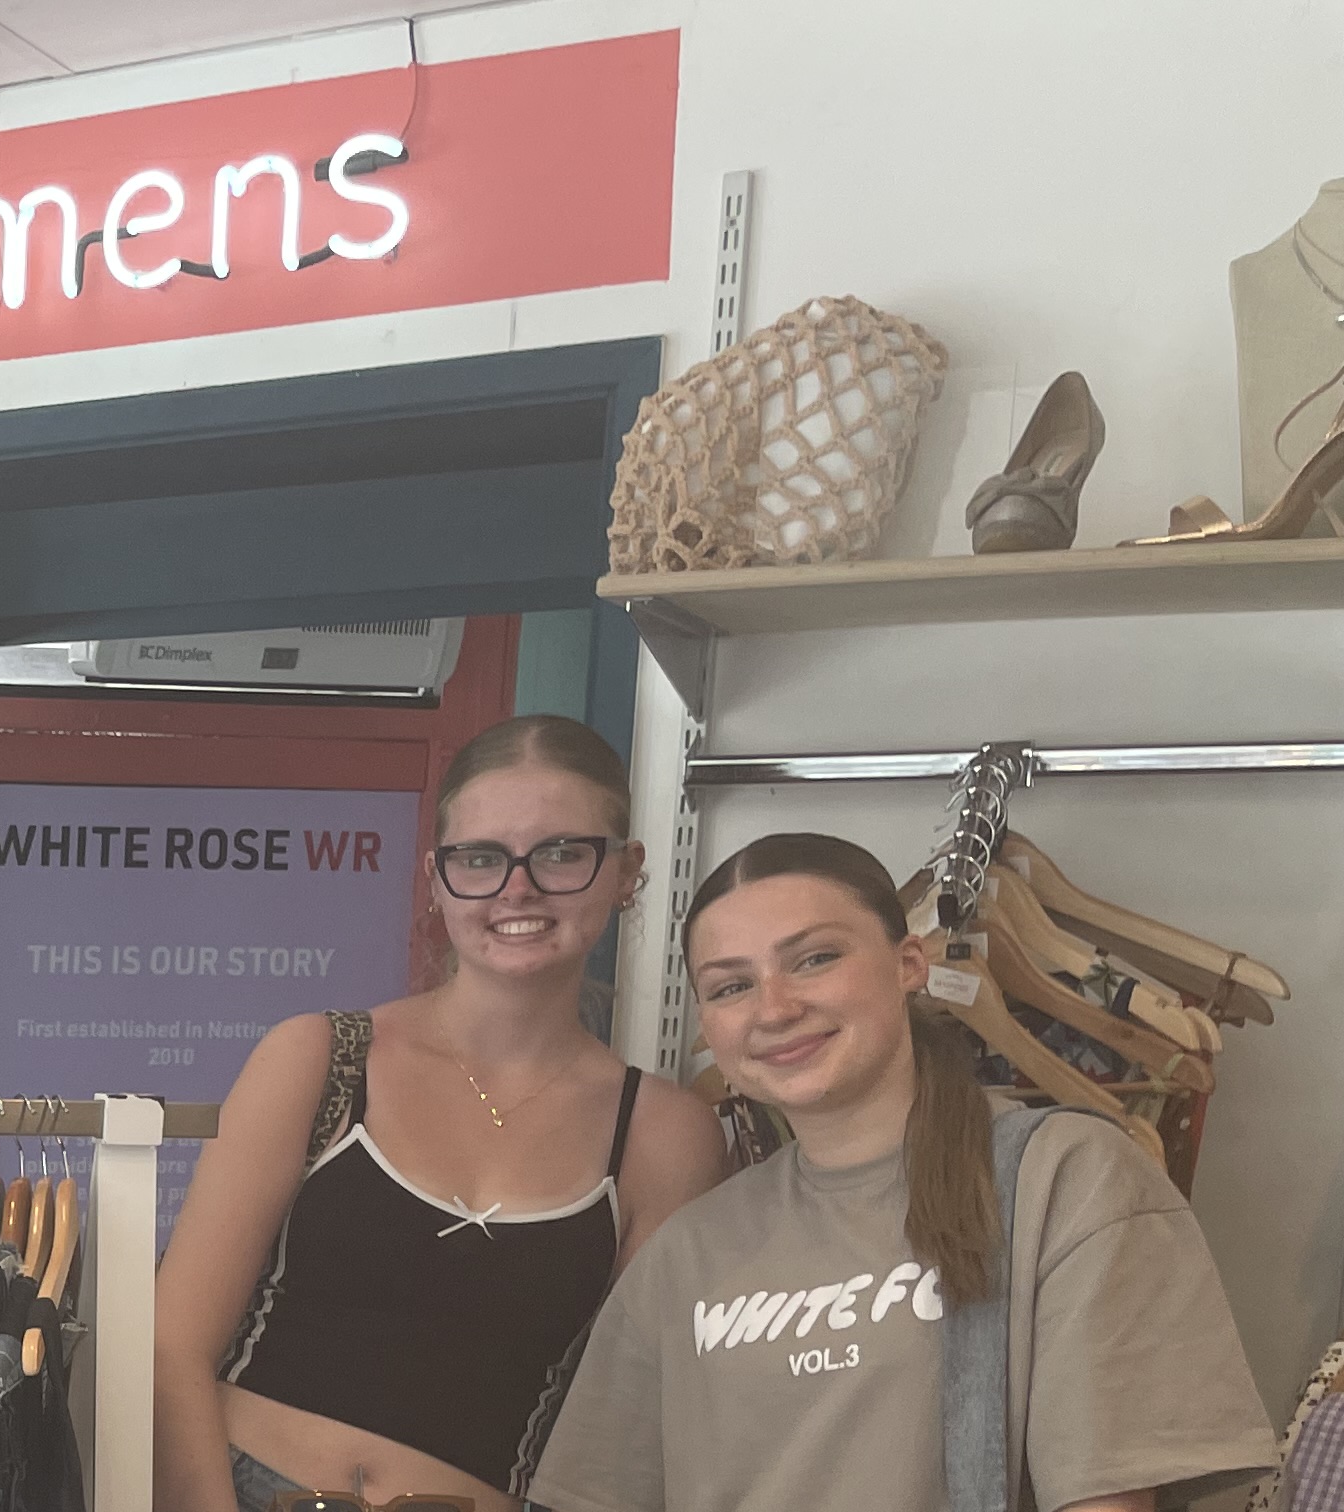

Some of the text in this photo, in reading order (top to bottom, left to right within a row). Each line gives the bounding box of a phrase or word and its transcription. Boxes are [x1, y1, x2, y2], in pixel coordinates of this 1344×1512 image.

[155, 645, 213, 662] Dimplex
[165, 827, 290, 871] ROSE
[304, 830, 382, 872] WR
[27, 945, 336, 977] THIS IS OUR STORY
[17, 1019, 272, 1039] First established in Nottin
[148, 1047, 195, 1066] 2010
[693, 1273, 874, 1358] WHITE
[789, 1343, 860, 1377] VOL.3
